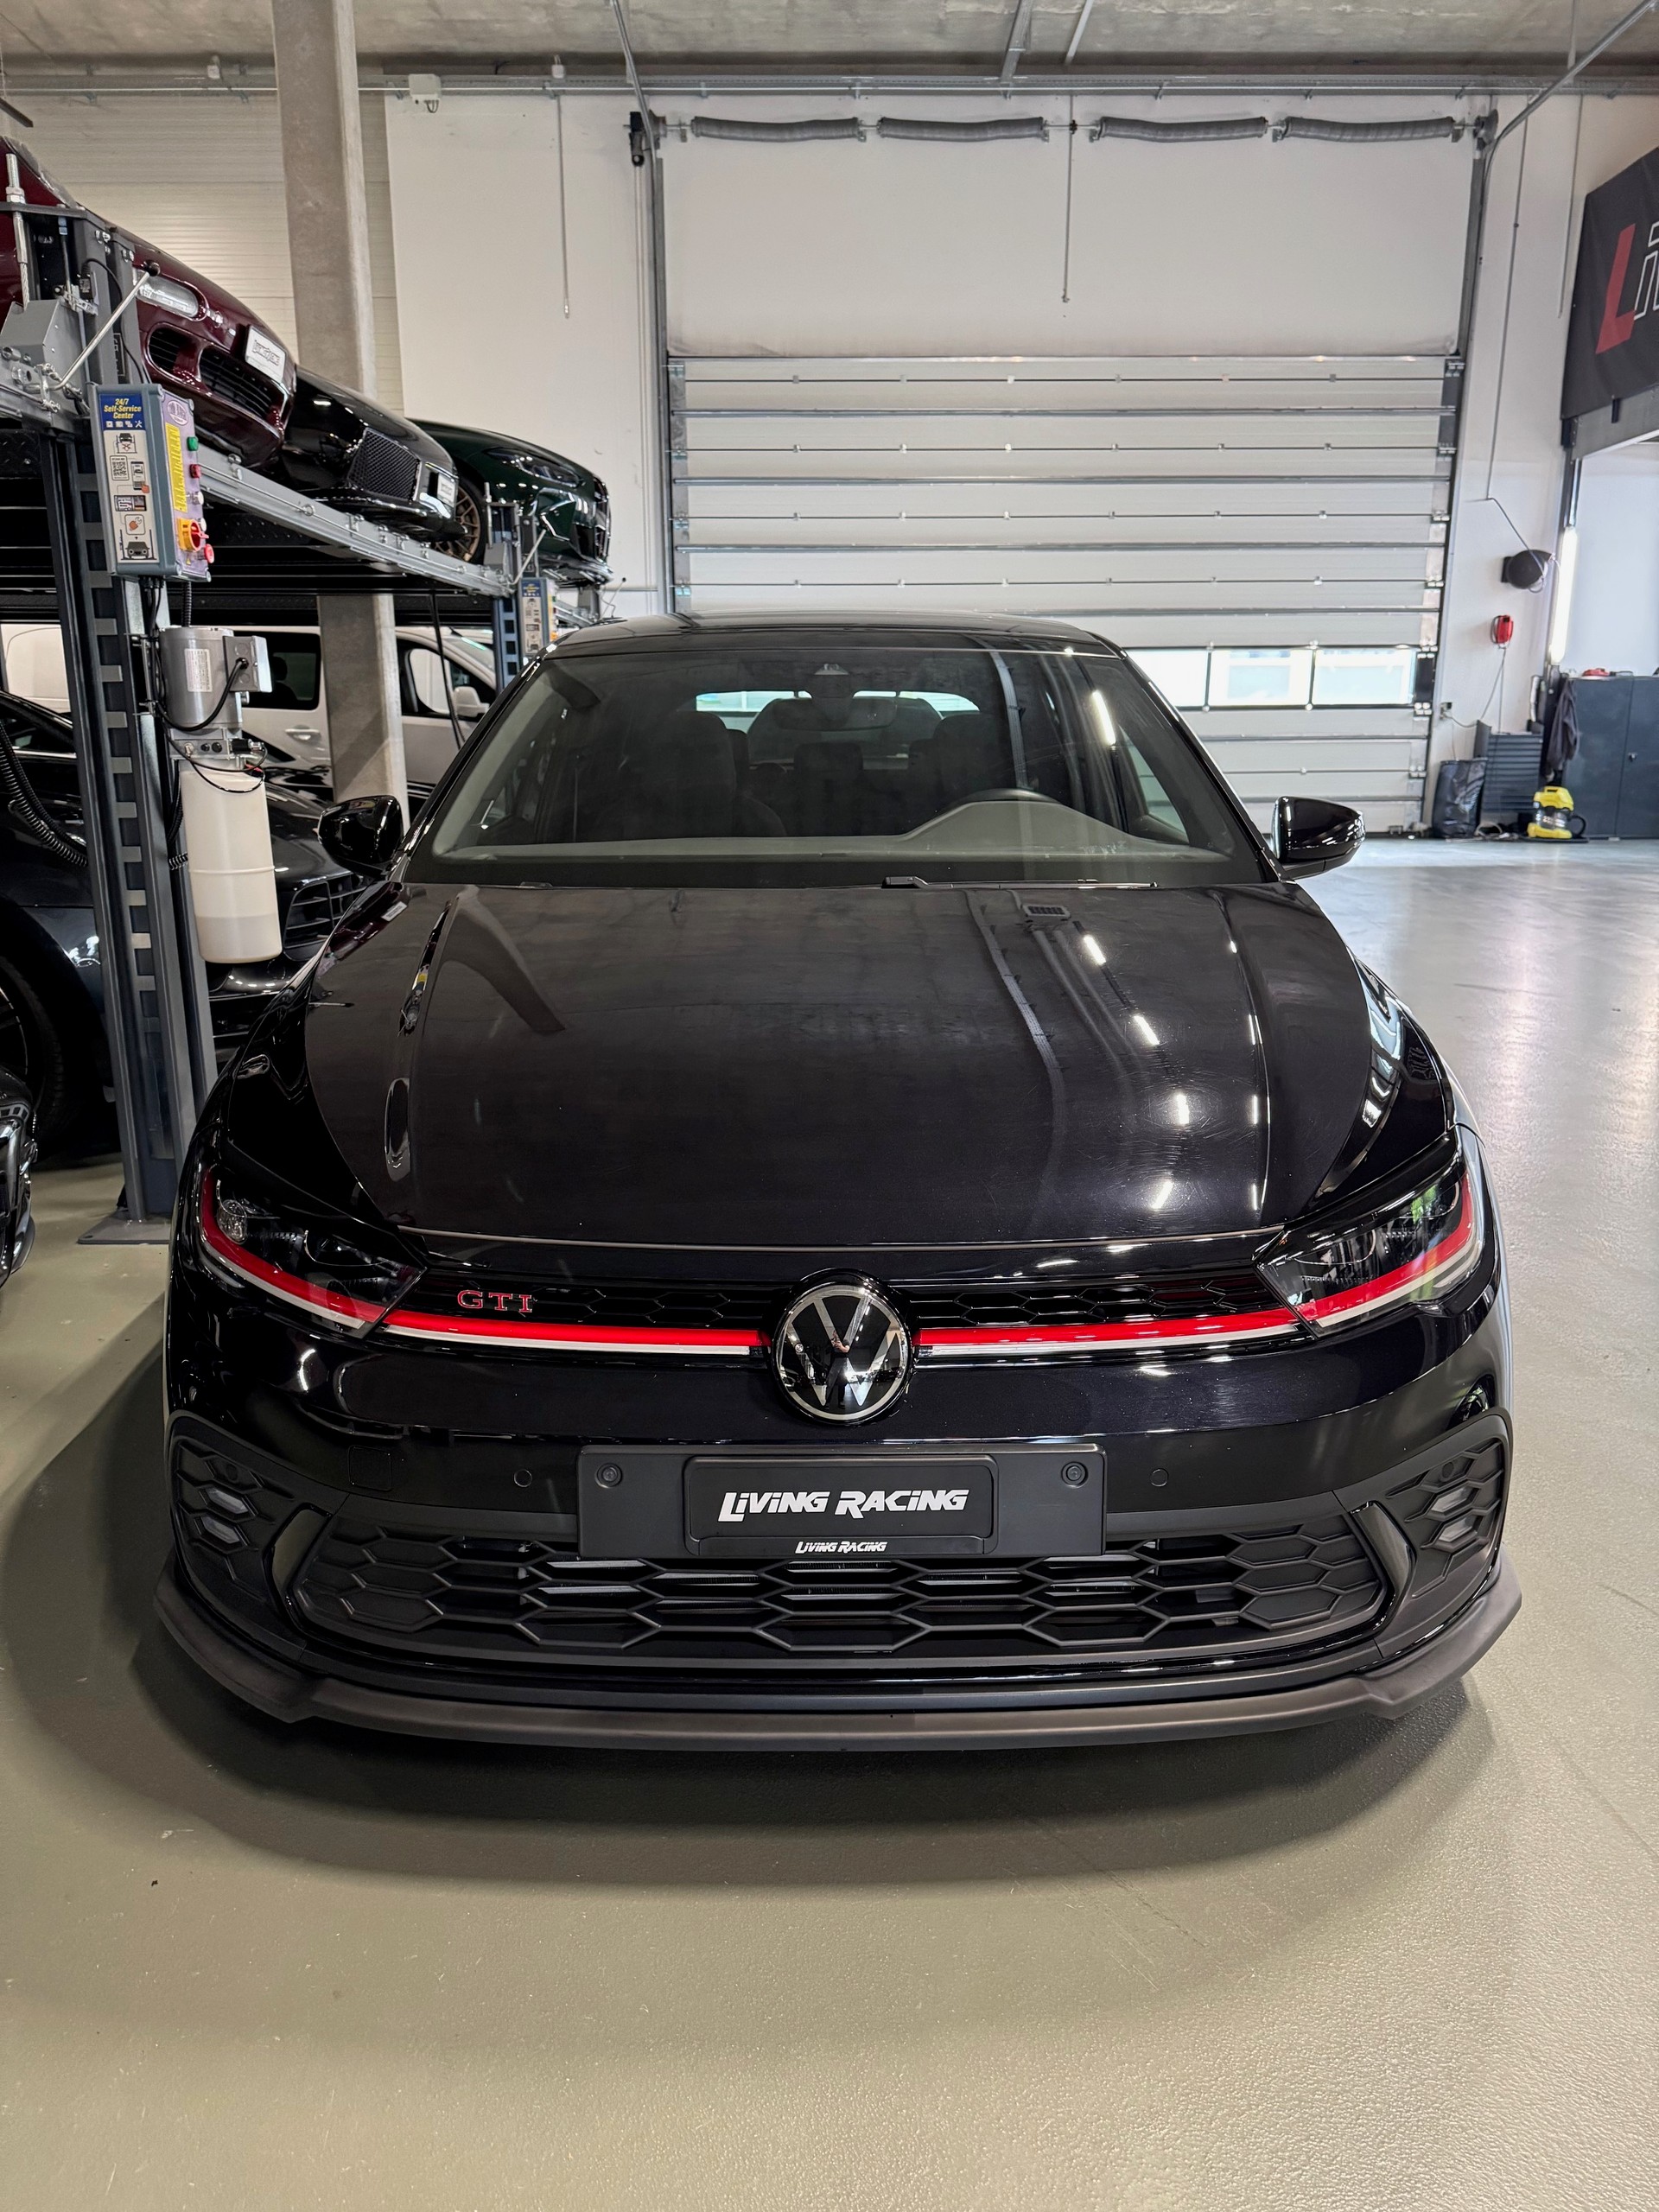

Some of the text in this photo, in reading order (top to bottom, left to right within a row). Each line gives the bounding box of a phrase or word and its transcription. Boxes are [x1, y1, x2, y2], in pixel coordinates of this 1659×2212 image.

[115, 397, 130, 406] 24/7
[457, 1289, 532, 1313] GTI
[779, 1284, 906, 1421] VW
